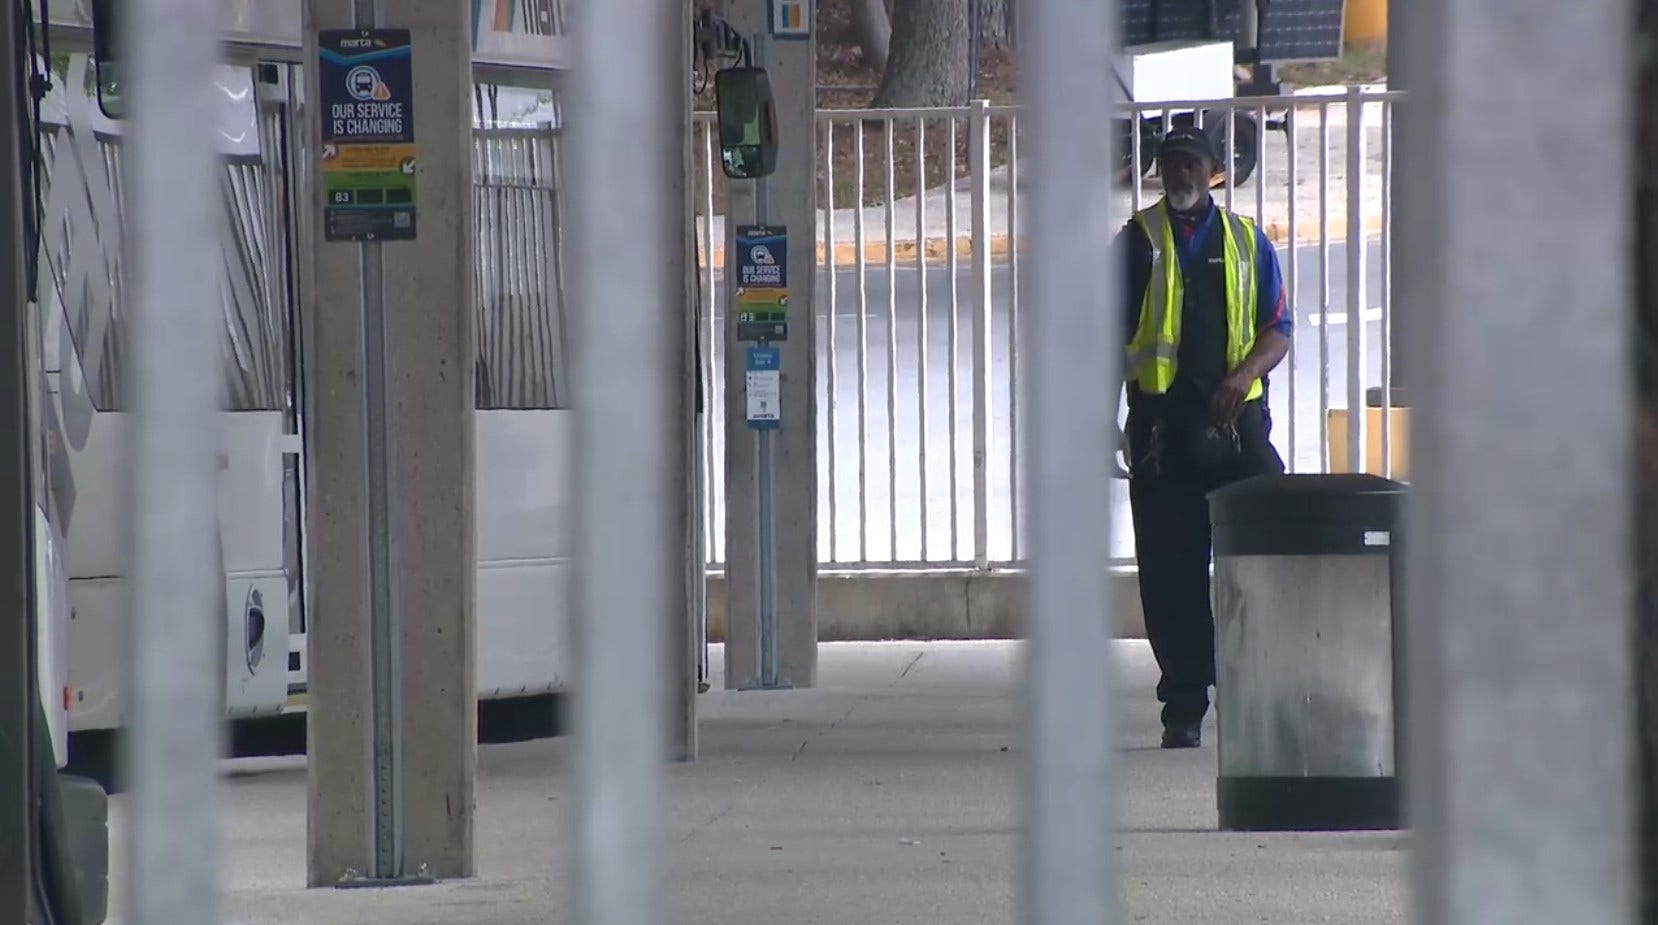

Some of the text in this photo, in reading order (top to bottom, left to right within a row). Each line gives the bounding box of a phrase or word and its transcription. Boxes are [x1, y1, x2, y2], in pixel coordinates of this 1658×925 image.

[340, 39, 371, 48] marta
[331, 103, 403, 119] OUR SERVICE
[333, 119, 403, 135] IS CHANGING
[742, 265, 780, 275] OUR SERVICE
[742, 274, 780, 283] IS CHANGING
